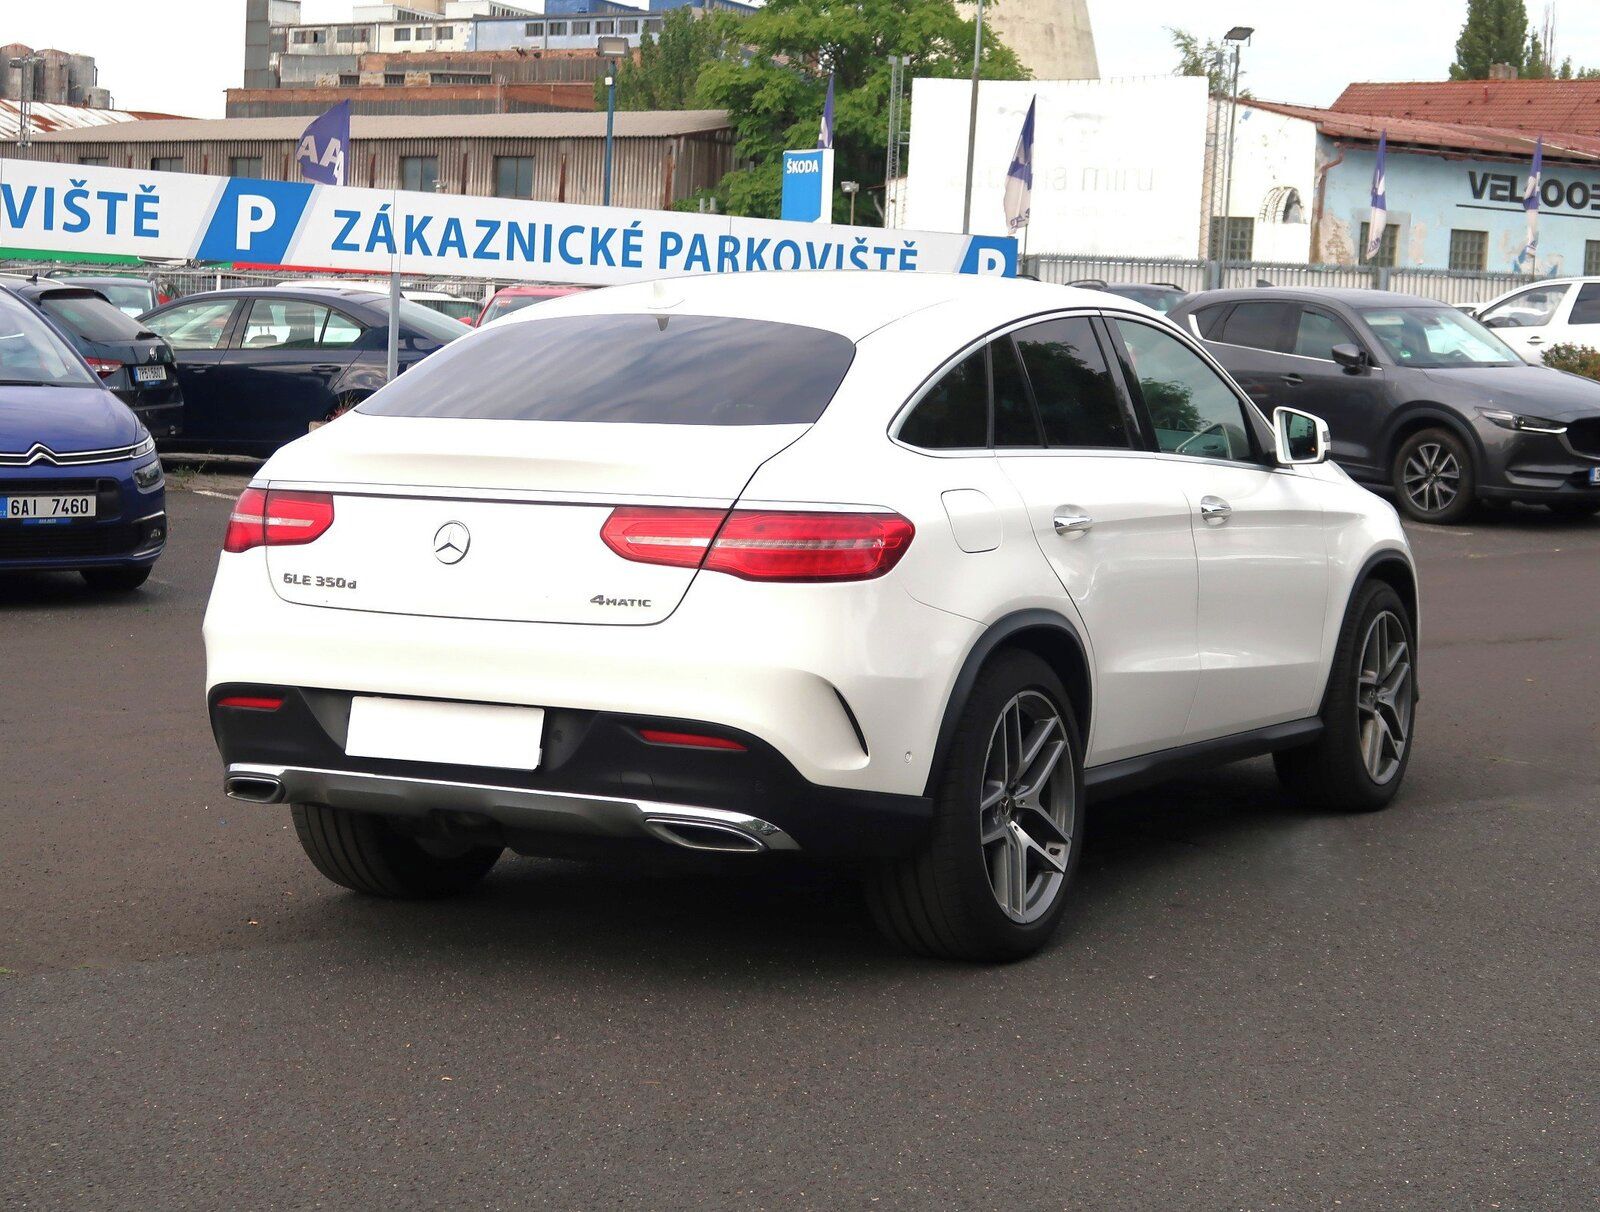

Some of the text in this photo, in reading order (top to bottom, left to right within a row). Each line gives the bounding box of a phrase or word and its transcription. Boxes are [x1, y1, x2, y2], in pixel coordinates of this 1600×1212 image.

[786, 158, 819, 174] ŠKODA
[236, 194, 276, 251] P
[331, 203, 643, 268] ZÁKAZNICKÉ
[52, 498, 89, 515] 7460
[284, 573, 311, 586] GLE
[590, 595, 651, 607] 4MATIC
